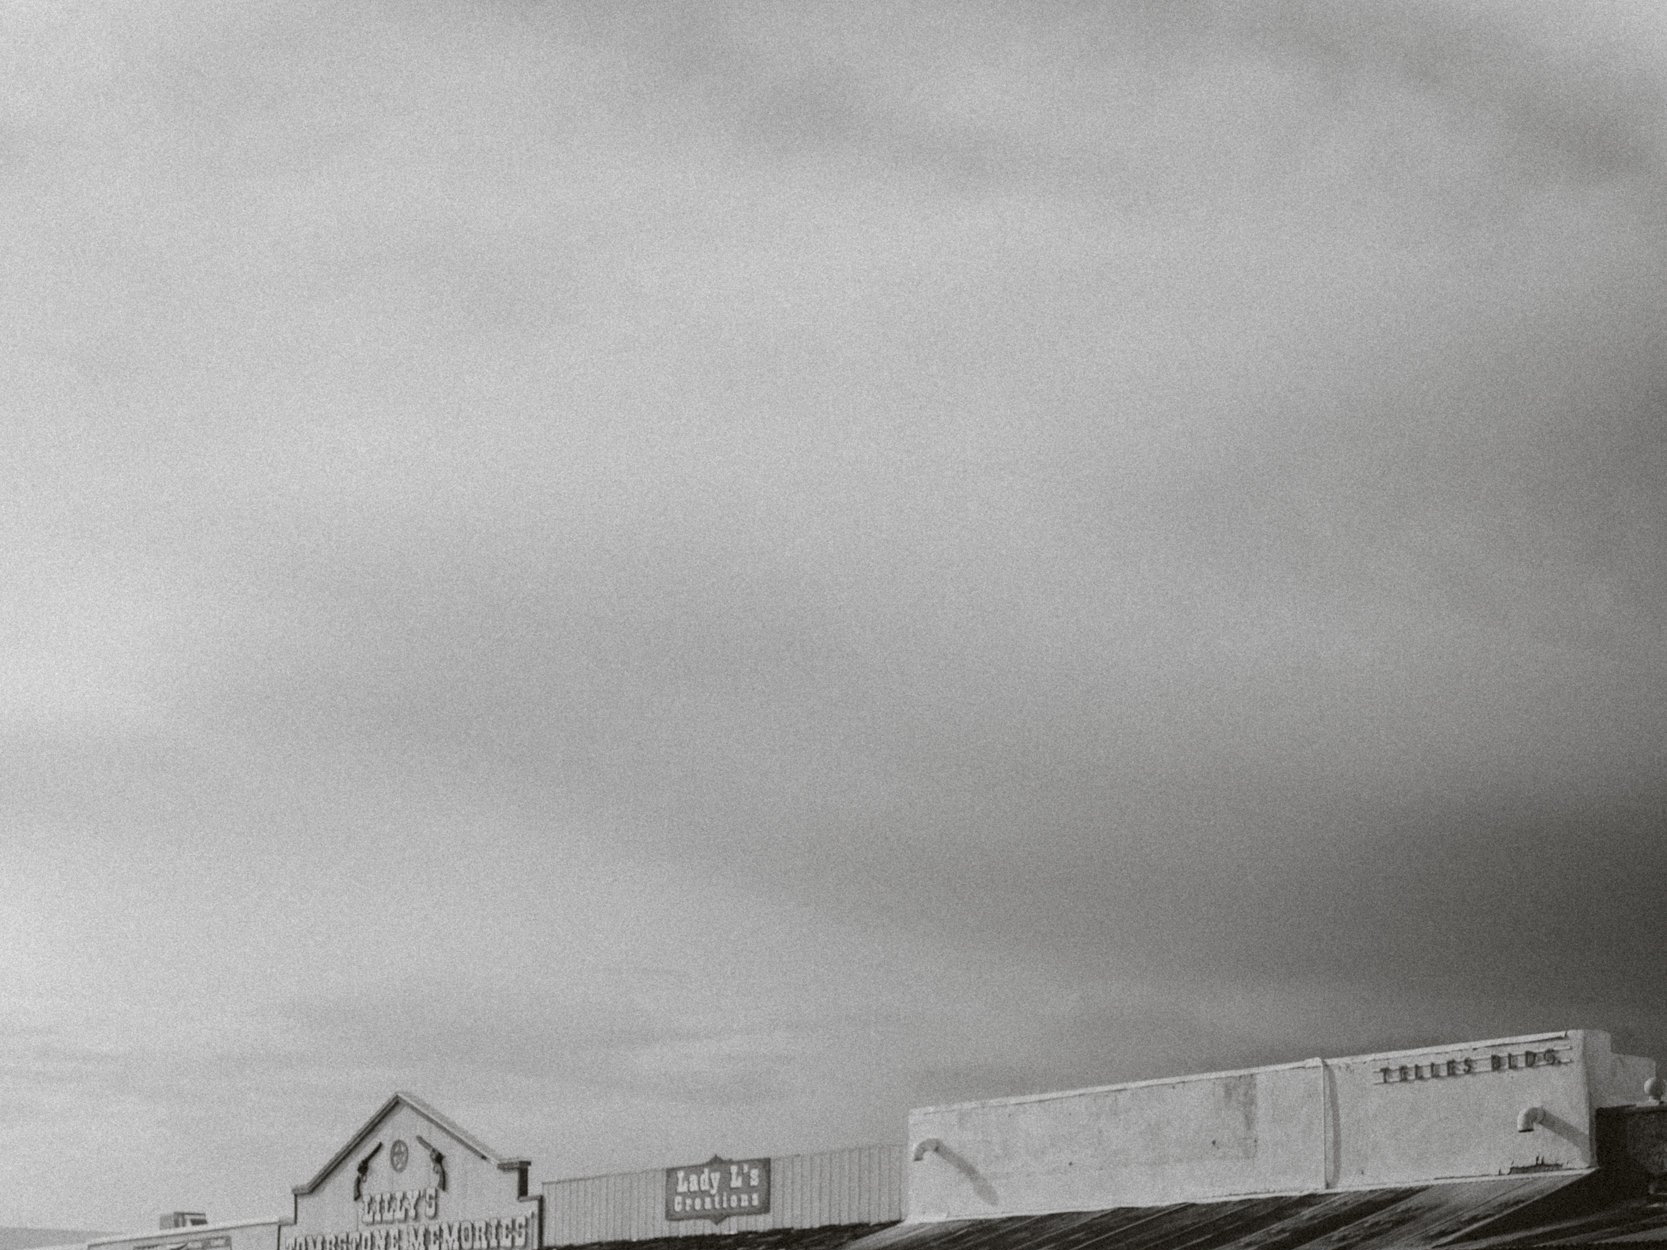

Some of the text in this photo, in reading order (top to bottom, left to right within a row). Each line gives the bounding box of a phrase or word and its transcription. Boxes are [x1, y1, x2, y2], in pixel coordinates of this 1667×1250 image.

[676, 1164, 760, 1195] Lady L's
[362, 1187, 438, 1224] LILLY'S
